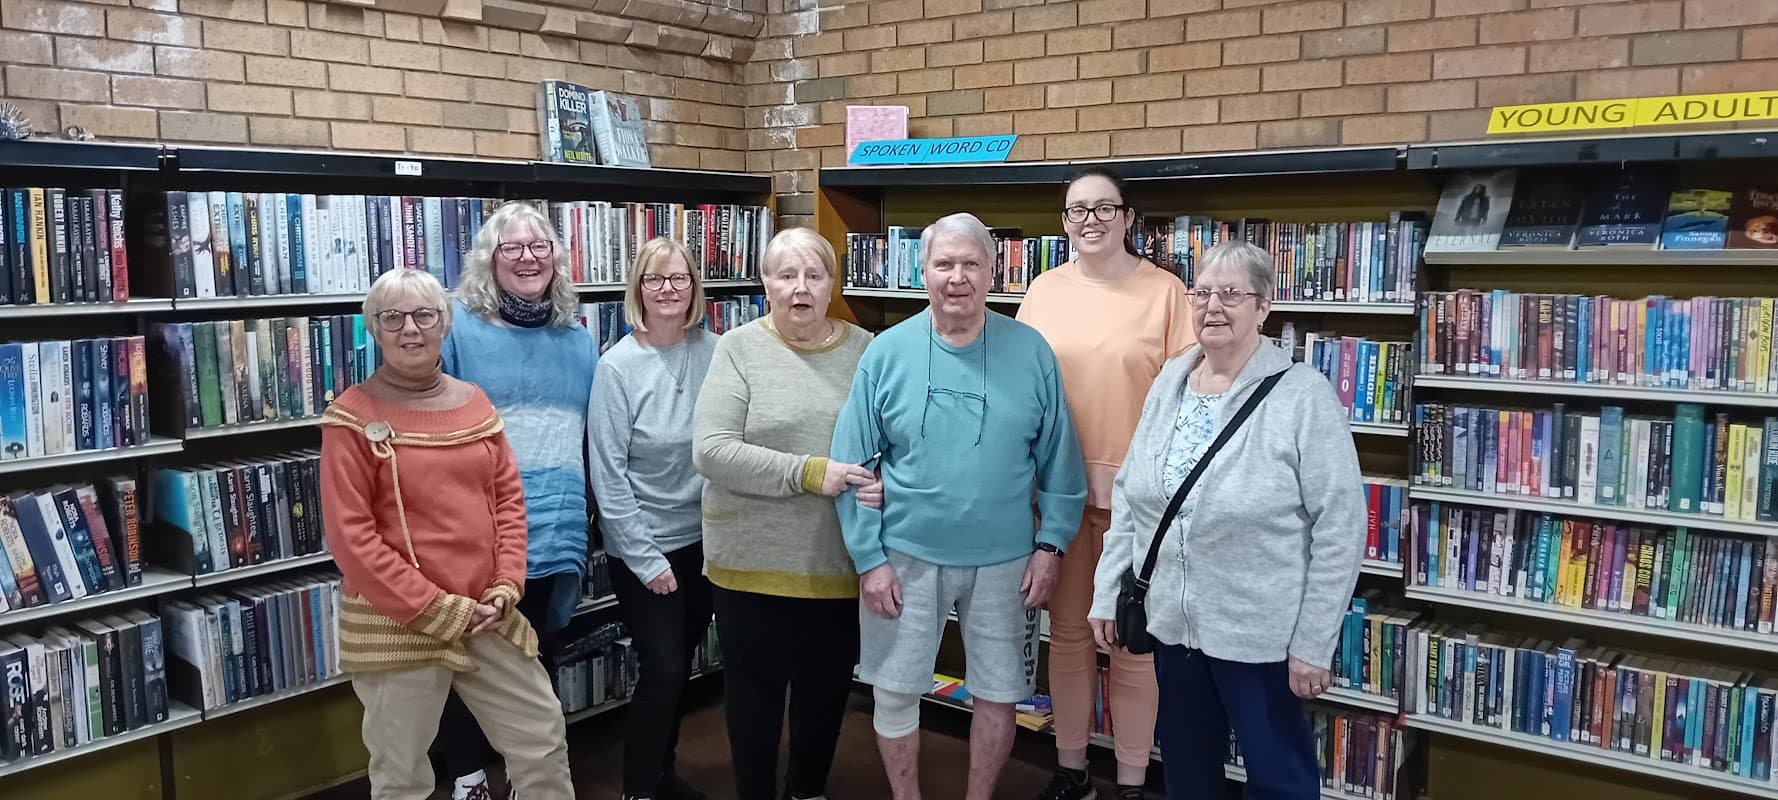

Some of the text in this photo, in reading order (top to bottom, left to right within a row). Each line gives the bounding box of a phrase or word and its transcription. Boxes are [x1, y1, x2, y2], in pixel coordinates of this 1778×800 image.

[558, 88, 586, 102] DOMINO
[560, 98, 587, 114] KILLER
[1500, 96, 1778, 129] YOUNG ADULT
[860, 140, 1011, 157] SPOKEN WORD CD
[34, 194, 43, 207] IAN
[84, 200, 92, 221] SARAH
[35, 210, 44, 240] RANKIN
[54, 194, 66, 253] ROBERT RANKIN
[109, 194, 124, 248] Kathy Reichs
[250, 210, 258, 235] CHRIS
[404, 202, 415, 264] JOHN SANDFORD
[431, 200, 441, 255] DOMINION
[294, 217, 305, 267] CHRIS RYAN
[1676, 235, 1722, 244] Finnegan
[1539, 299, 1552, 323] KAI-RO
[100, 345, 109, 370] Shiver
[1760, 335, 1770, 352] BOYS
[28, 354, 40, 415] Stella RIMINGTON
[1366, 355, 1376, 404] HEROIC
[81, 404, 90, 437] ROBARDS
[101, 402, 111, 435] ROBARDS
[189, 475, 199, 501] Karin
[226, 472, 239, 526] Karin Slaughter
[243, 468, 257, 537] Karin Slaughter
[62, 500, 75, 529] ROBERTS
[123, 490, 139, 561] PETER ROBINSON
[214, 523, 226, 555] genesis
[52, 564, 60, 577] High
[1637, 545, 1654, 588] CHAOS CODE
[144, 636, 153, 654] FIRE
[1024, 608, 1036, 685] ench.
[6, 661, 25, 708] ROSE
[1476, 662, 1485, 686] SILVA
[1706, 687, 1717, 735] SPACE COWBOY
